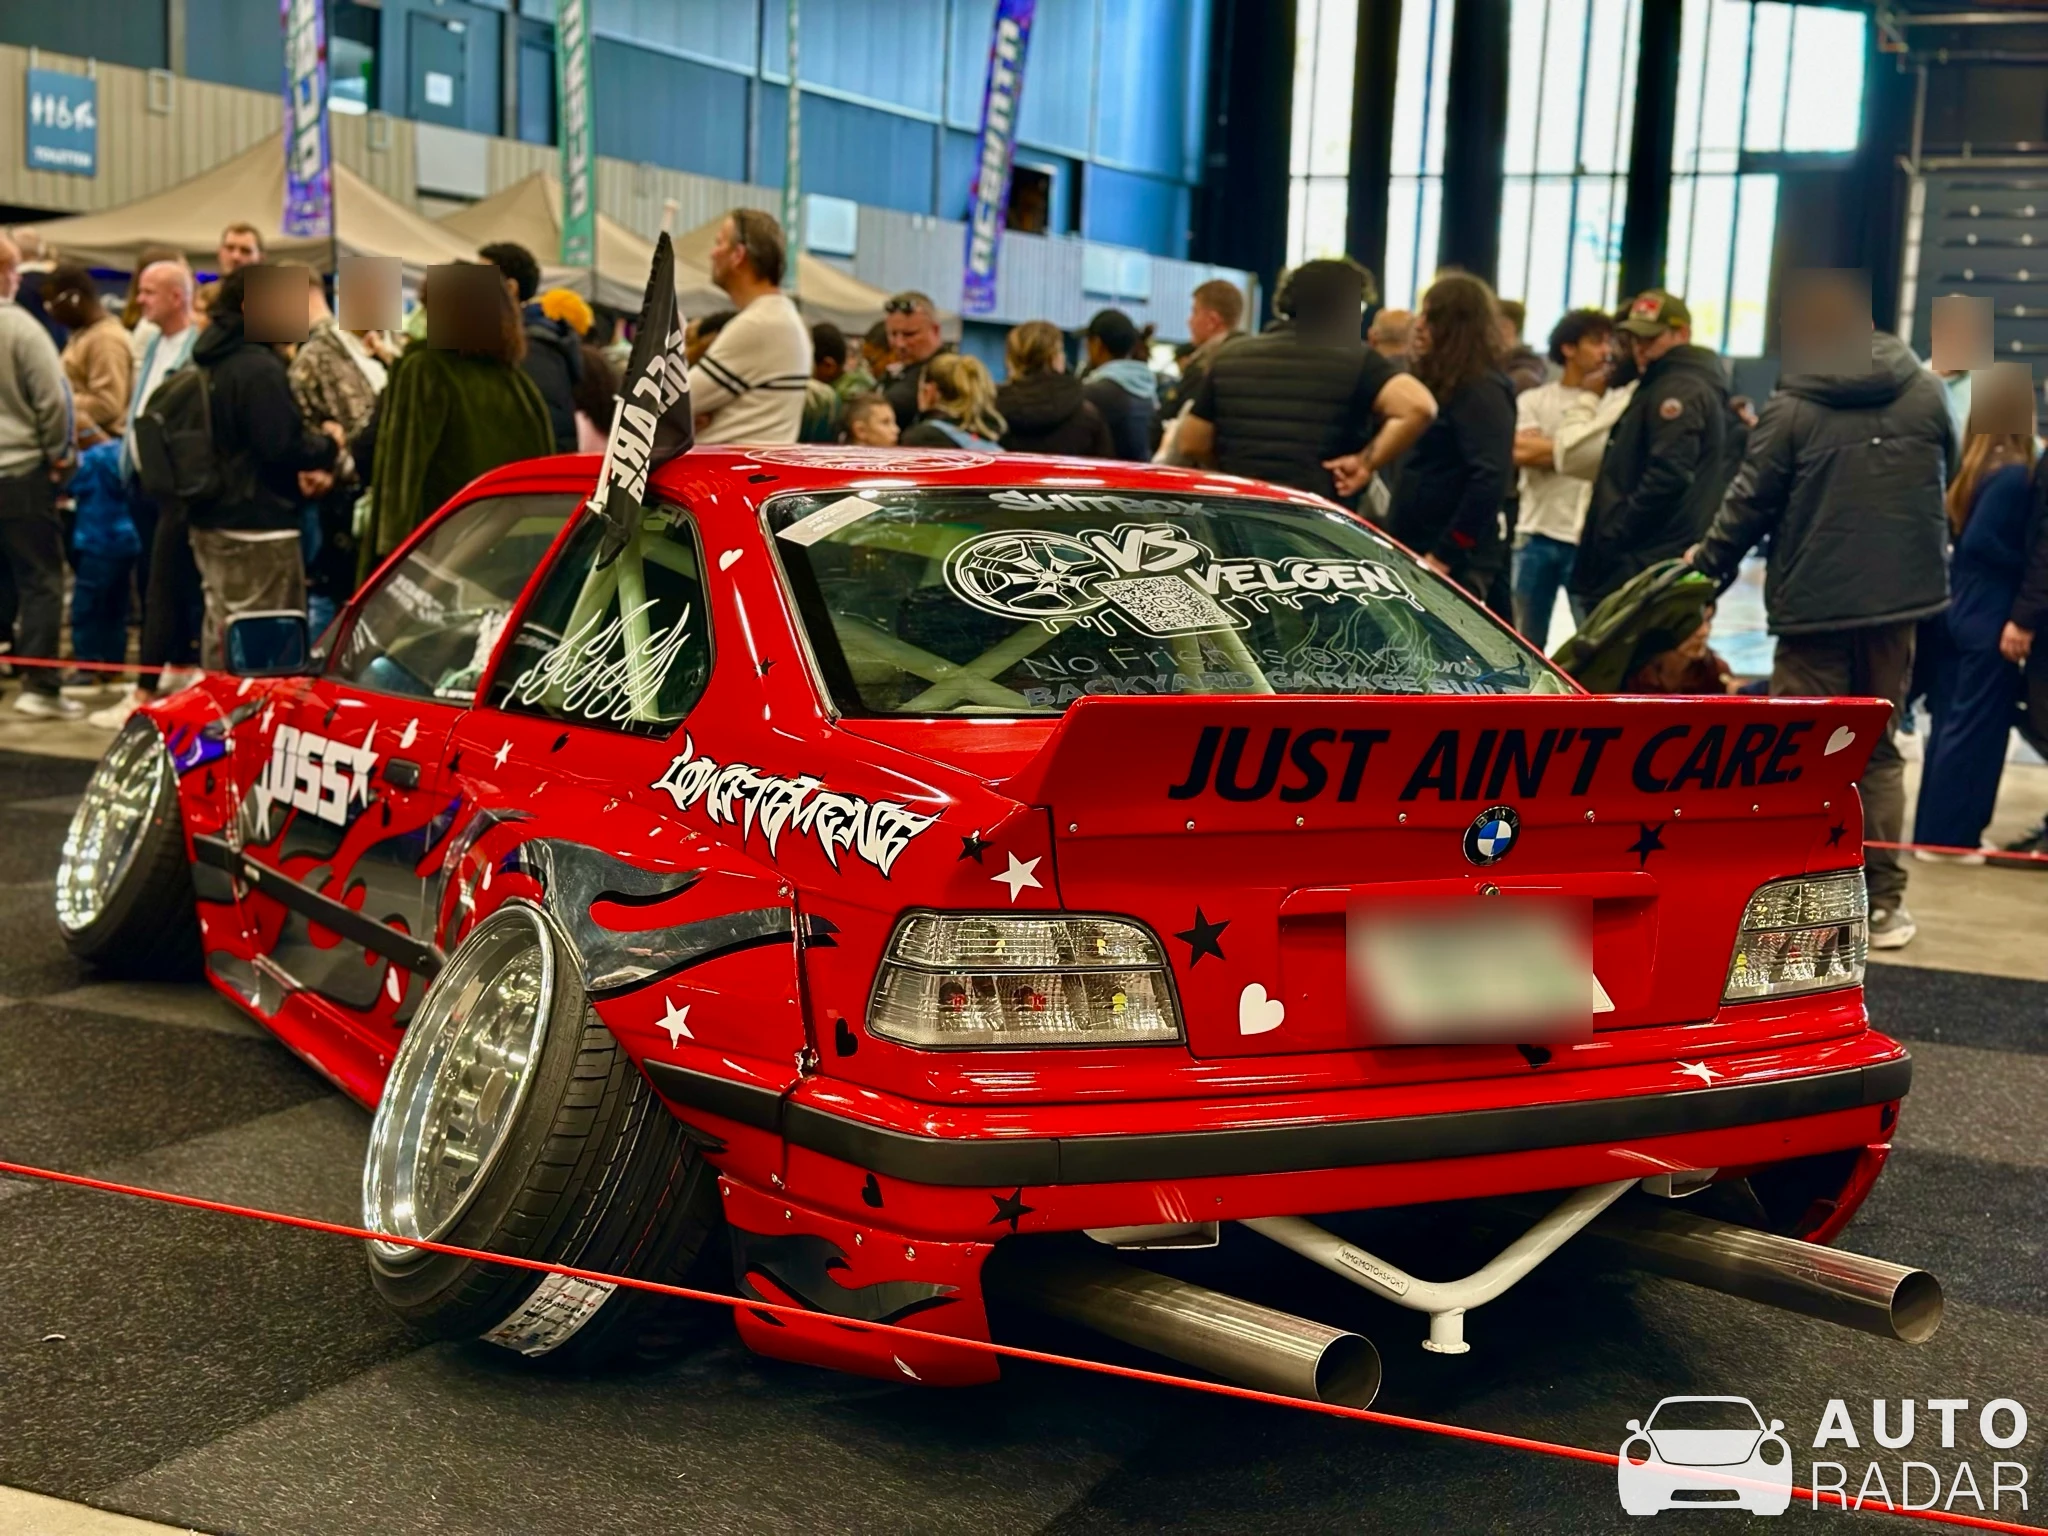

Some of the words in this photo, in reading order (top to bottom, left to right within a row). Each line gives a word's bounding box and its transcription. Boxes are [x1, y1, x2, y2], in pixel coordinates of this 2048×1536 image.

[988, 490, 1218, 518] SHITBOX
[1092, 527, 1200, 574] VS
[1185, 562, 1399, 597] VELGEN
[1022, 654, 1099, 680] No
[1109, 645, 1288, 671] Friends
[1024, 672, 1255, 708] BACKYARD
[1266, 670, 1423, 693] GARAGE
[1168, 726, 1390, 803] JUST
[1400, 726, 1624, 802] AIN'T
[1631, 720, 1817, 794] CARE.
